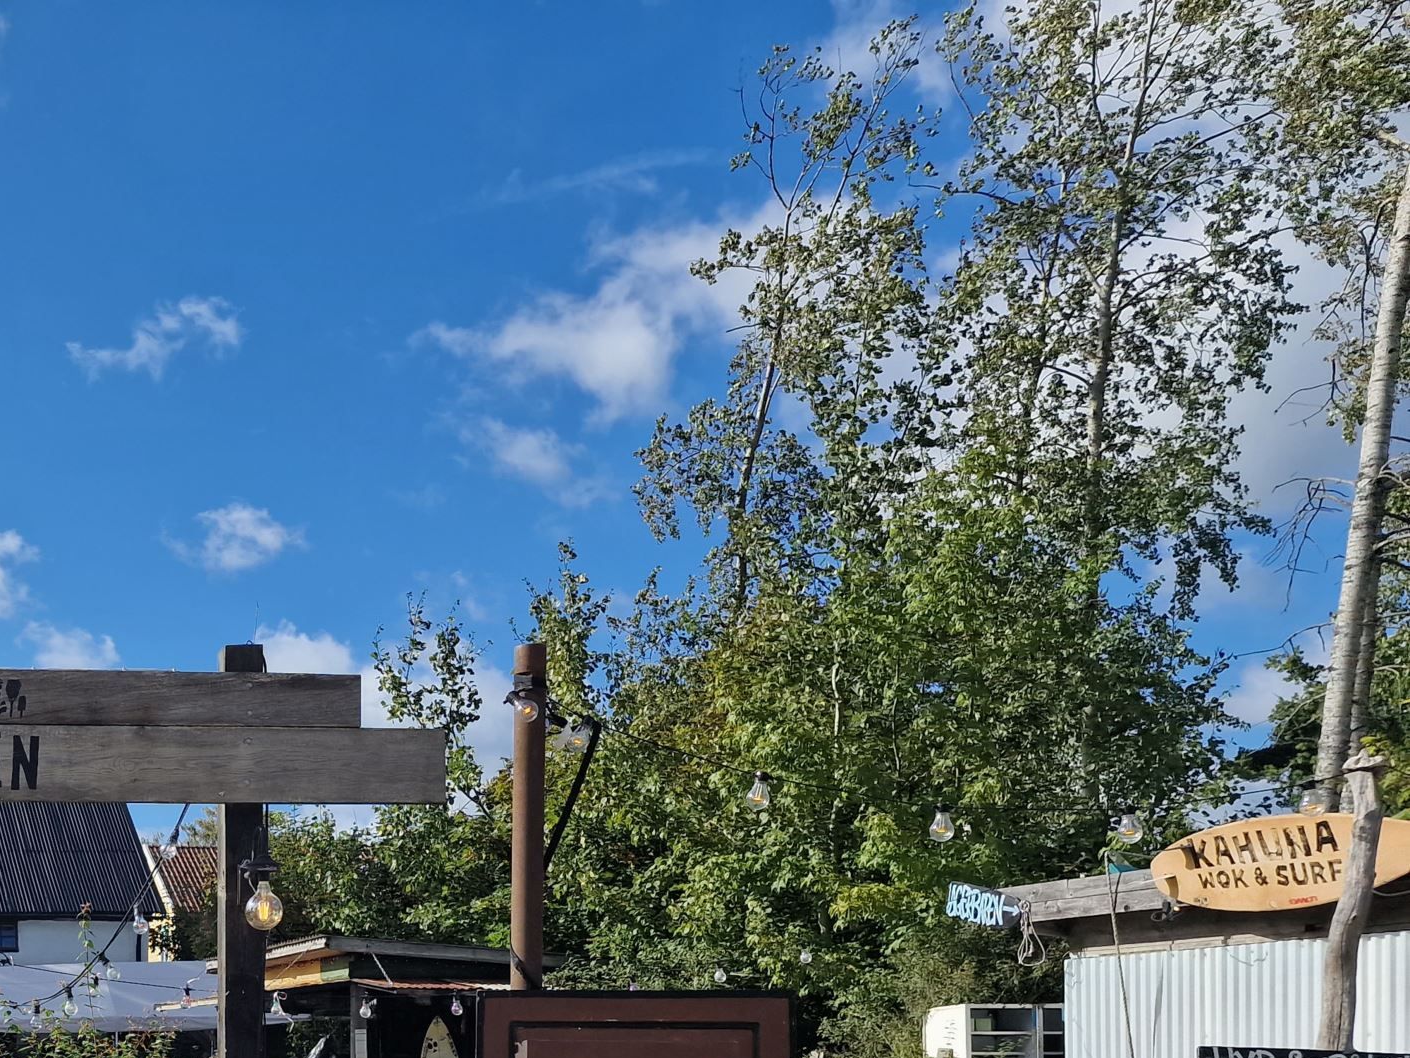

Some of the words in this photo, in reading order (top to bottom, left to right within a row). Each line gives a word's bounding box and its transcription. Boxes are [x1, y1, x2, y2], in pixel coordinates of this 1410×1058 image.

[1187, 820, 1339, 869] KAHUNA
[1198, 867, 1245, 889] WOK
[1254, 867, 1269, 886] &
[1276, 858, 1342, 886] SURF
